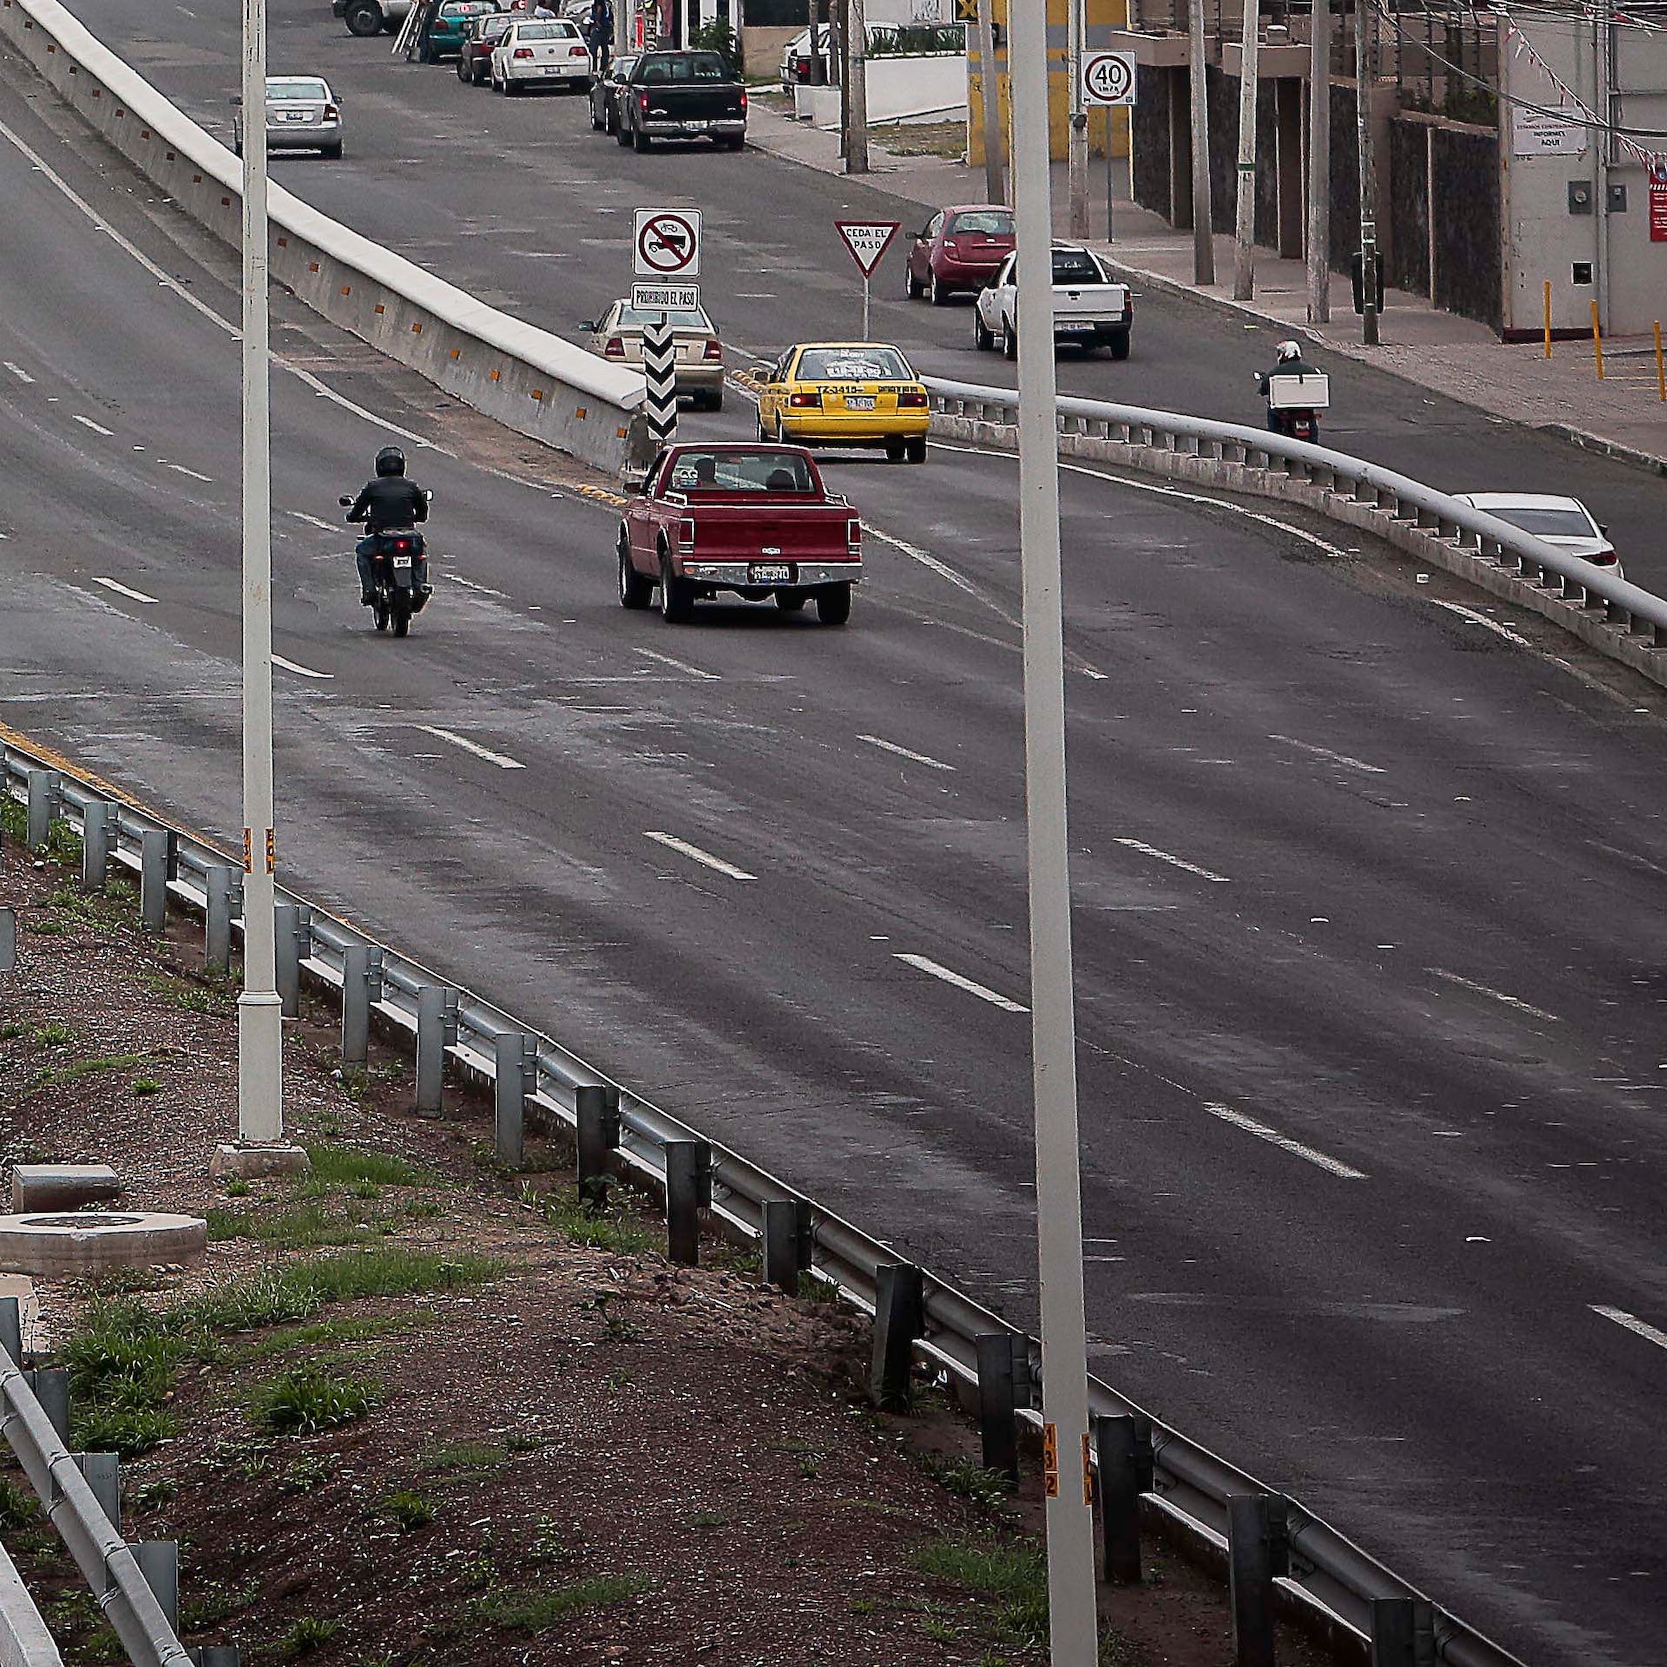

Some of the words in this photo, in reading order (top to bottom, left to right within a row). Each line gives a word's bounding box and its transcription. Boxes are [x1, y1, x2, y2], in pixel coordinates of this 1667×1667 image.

[1094, 64, 1122, 85] 40
[846, 228, 872, 238] CEDA
[875, 228, 887, 238] EL
[854, 240, 882, 250] PASO
[636, 289, 669, 304] PROHIBIDO
[670, 291, 678, 305] EL
[679, 291, 695, 306] PASO
